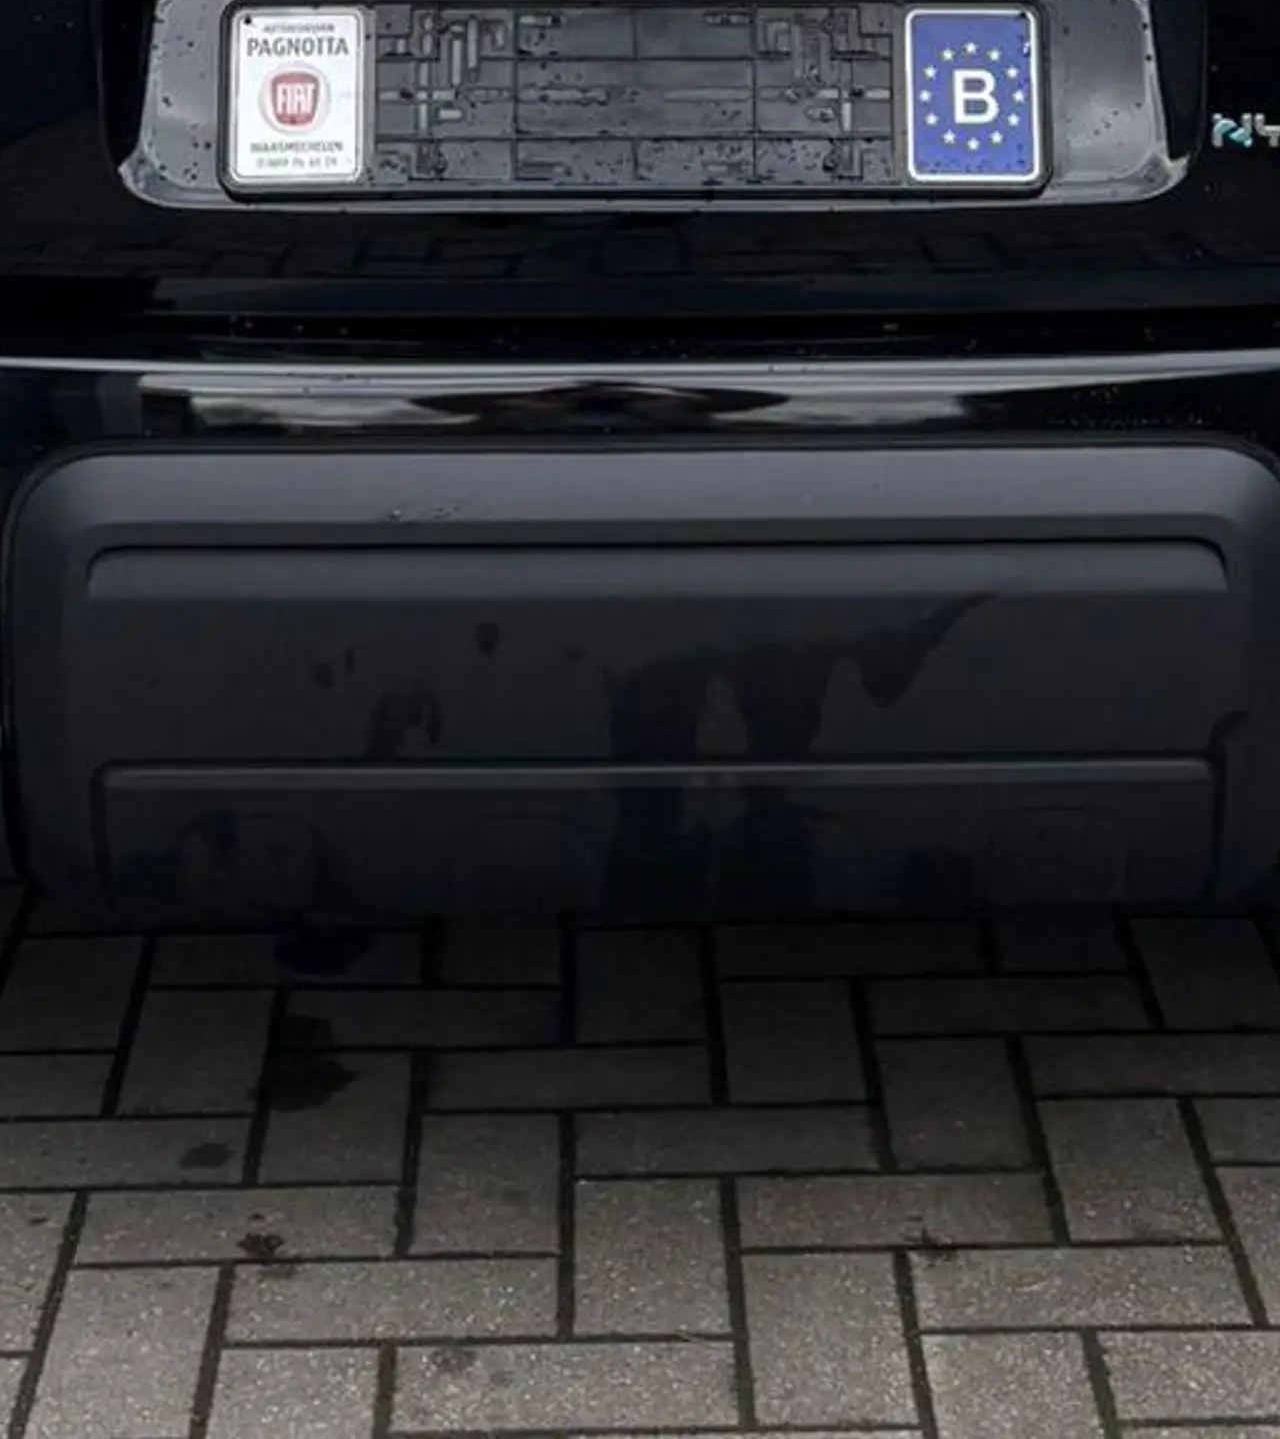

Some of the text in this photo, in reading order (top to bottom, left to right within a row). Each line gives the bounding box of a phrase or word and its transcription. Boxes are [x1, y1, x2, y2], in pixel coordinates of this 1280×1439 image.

[246, 36, 350, 57] PAGNOTTA
[276, 82, 316, 115] FIAT
[953, 68, 1000, 125] B
